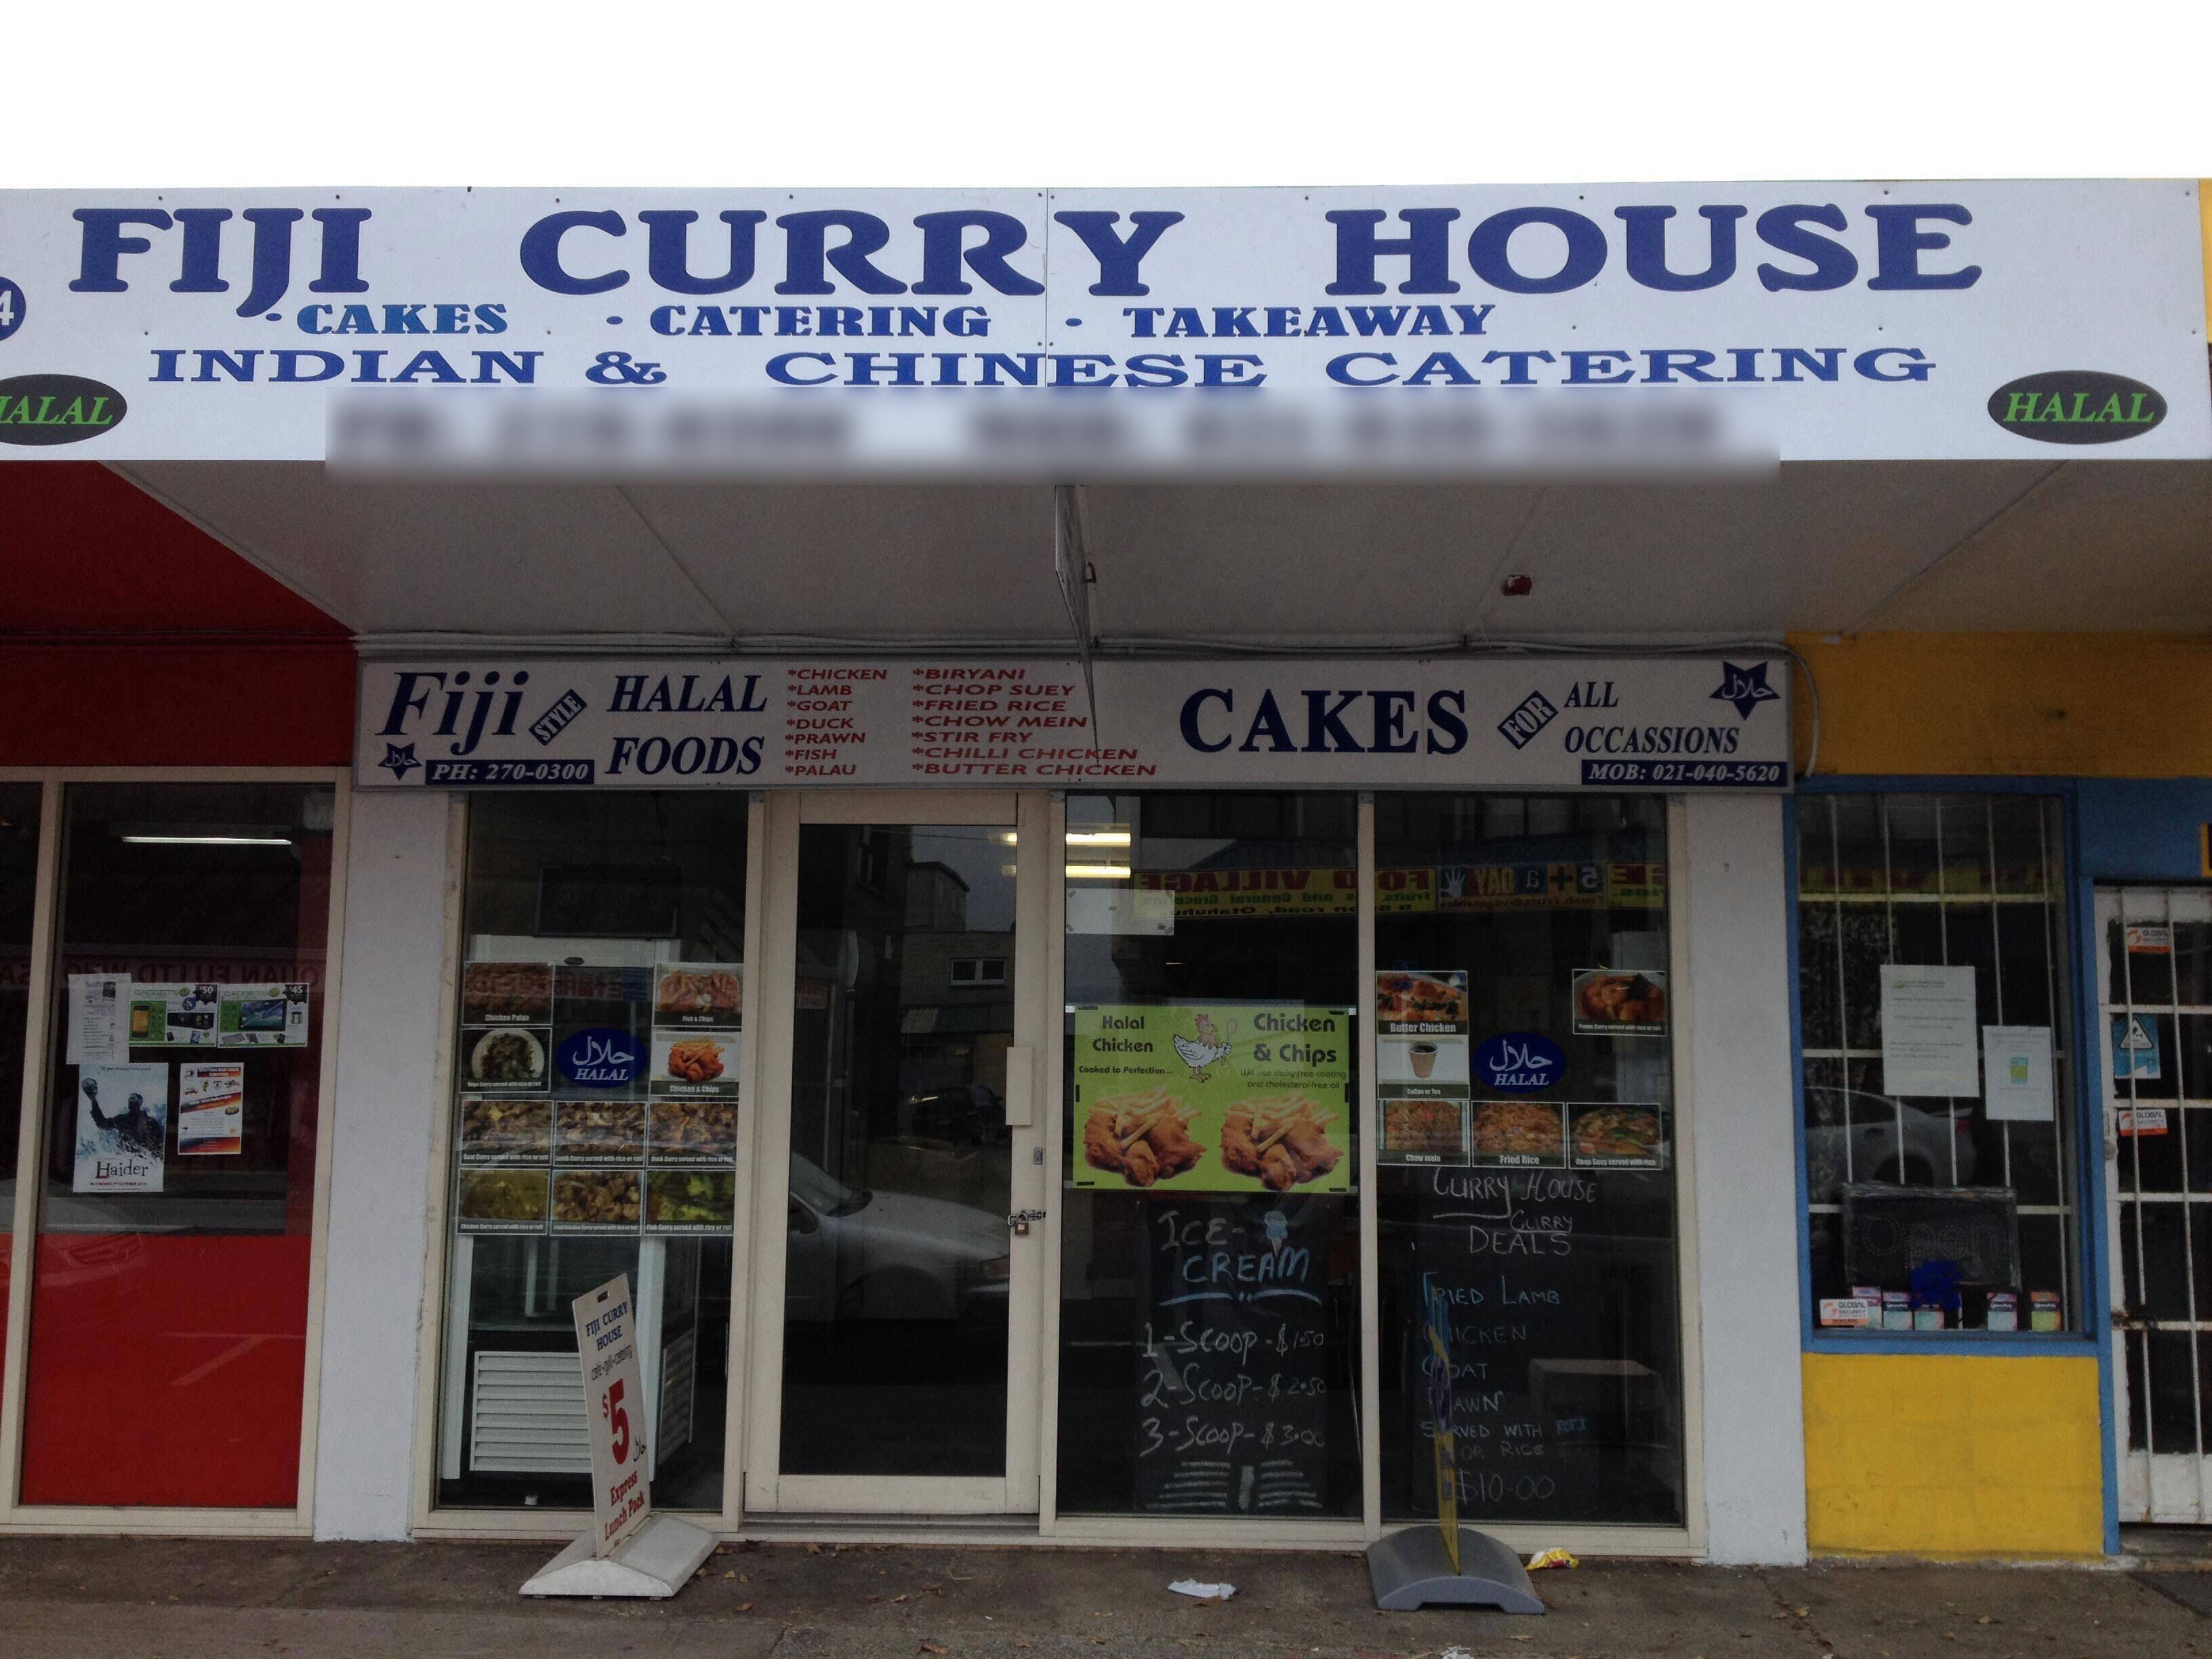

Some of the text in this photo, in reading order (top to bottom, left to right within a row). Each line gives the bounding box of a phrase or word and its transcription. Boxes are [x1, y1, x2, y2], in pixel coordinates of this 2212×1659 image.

[68, 203, 1982, 318] FIJI CURRY HOUSE
[296, 304, 1496, 337] CAKES CATERING TAKEAWAY
[148, 347, 1937, 388] INDIAN & CHINESE CATERING
[2003, 392, 2156, 424] HALAL
[606, 674, 769, 712] HALAL
[1009, 684, 1076, 697] SUEY
[1563, 681, 1620, 709] ALL
[375, 670, 529, 756] Fiji
[1007, 699, 1067, 712] RICE
[533, 694, 583, 743] STYLE
[1017, 716, 1088, 729] MEIN
[1179, 687, 1470, 755] CAKES
[1500, 695, 1555, 748] FOR
[988, 731, 1033, 743] FRY
[1563, 726, 1740, 754] OCCASSIONS
[605, 735, 766, 776] FOODS
[1018, 748, 1139, 760] CHICKEN
[432, 764, 589, 781] PH: 270-0300
[1036, 764, 1158, 777] CHICKEN
[1588, 763, 1780, 783] MOB: 021-040-5620
[1102, 1015, 1145, 1029] Halal
[1254, 1012, 1335, 1032] Chicken
[1390, 1023, 1456, 1033] Butter Chicken
[572, 1035, 634, 1066] حلال
[1092, 1038, 1153, 1052] Chicken
[1254, 1044, 1337, 1067] & Chips
[1490, 1039, 1553, 1071] حلال
[575, 1068, 630, 1082] HALAL
[1079, 1065, 1110, 1073] Cooked
[1316, 1069, 1346, 1080] coating
[1494, 1073, 1550, 1086] HALAL
[670, 1084, 695, 1092] Chicken
[96, 1159, 148, 1179] Haider
[1406, 1153, 1441, 1162] Chow mein
[1500, 1155, 1540, 1165] Fried Rice
[1520, 1170, 1597, 1203] HOUSE
[1471, 1225, 1572, 1256] DEALS
[1183, 1246, 1311, 1283] CREAM
[1502, 1275, 1561, 1305] LAMB
[586, 1301, 628, 1337] FIJI CURRY
[596, 1325, 622, 1351] HOUSE
[1420, 1422, 1490, 1439] SRVED
[1504, 1424, 1542, 1437] WITH
[610, 1471, 638, 1507] Express
[605, 1490, 645, 1541] Lunch Pack
